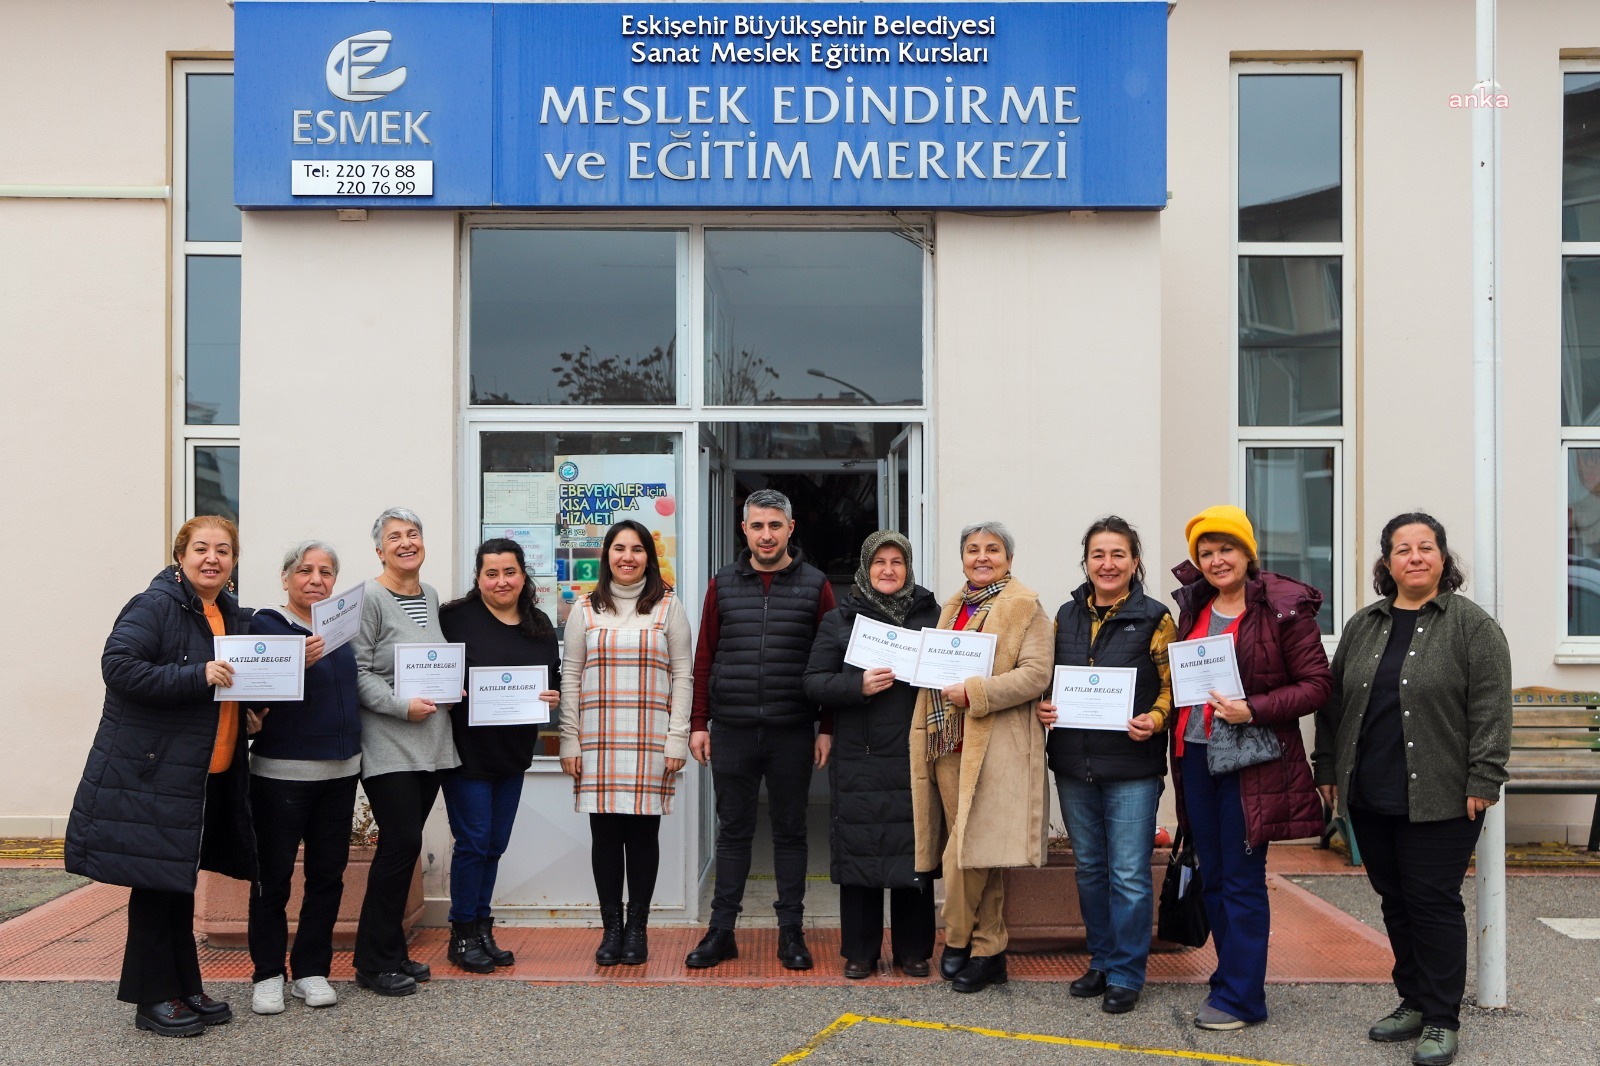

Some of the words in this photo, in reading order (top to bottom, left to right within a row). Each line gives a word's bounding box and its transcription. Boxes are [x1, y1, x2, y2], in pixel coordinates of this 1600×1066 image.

[622, 15, 728, 38] Eskişehir
[734, 15, 867, 39] Büyükşehir
[875, 15, 996, 39] Belediyesi
[631, 42, 700, 63] Sanat
[710, 42, 800, 63] Meslek
[811, 42, 890, 69] Eğitim
[898, 42, 988, 63] Kursları
[539, 85, 750, 125] MESLEK
[773, 76, 1081, 125] EDİNDİRME
[293, 110, 431, 145] ESMEK
[544, 152, 606, 180] ve
[629, 130, 812, 180] EĞİTİM
[832, 130, 1067, 180] MERKEZİ
[303, 164, 330, 178] Tel:
[336, 164, 366, 178] 220
[371, 164, 390, 178] 76
[395, 164, 416, 178] 88
[336, 181, 366, 194] 220
[371, 181, 391, 194] 76
[395, 181, 416, 195] 99
[560, 483, 644, 497] EBEVEYNLER
[645, 486, 668, 499] için
[560, 497, 590, 511] KISA
[594, 497, 639, 511] MOLA
[560, 511, 614, 525] HİZMETİ
[582, 563, 592, 579] 3
[862, 633, 889, 647] KATILIM
[928, 647, 954, 656] KATILIM
[1180, 659, 1203, 669] KATILIM
